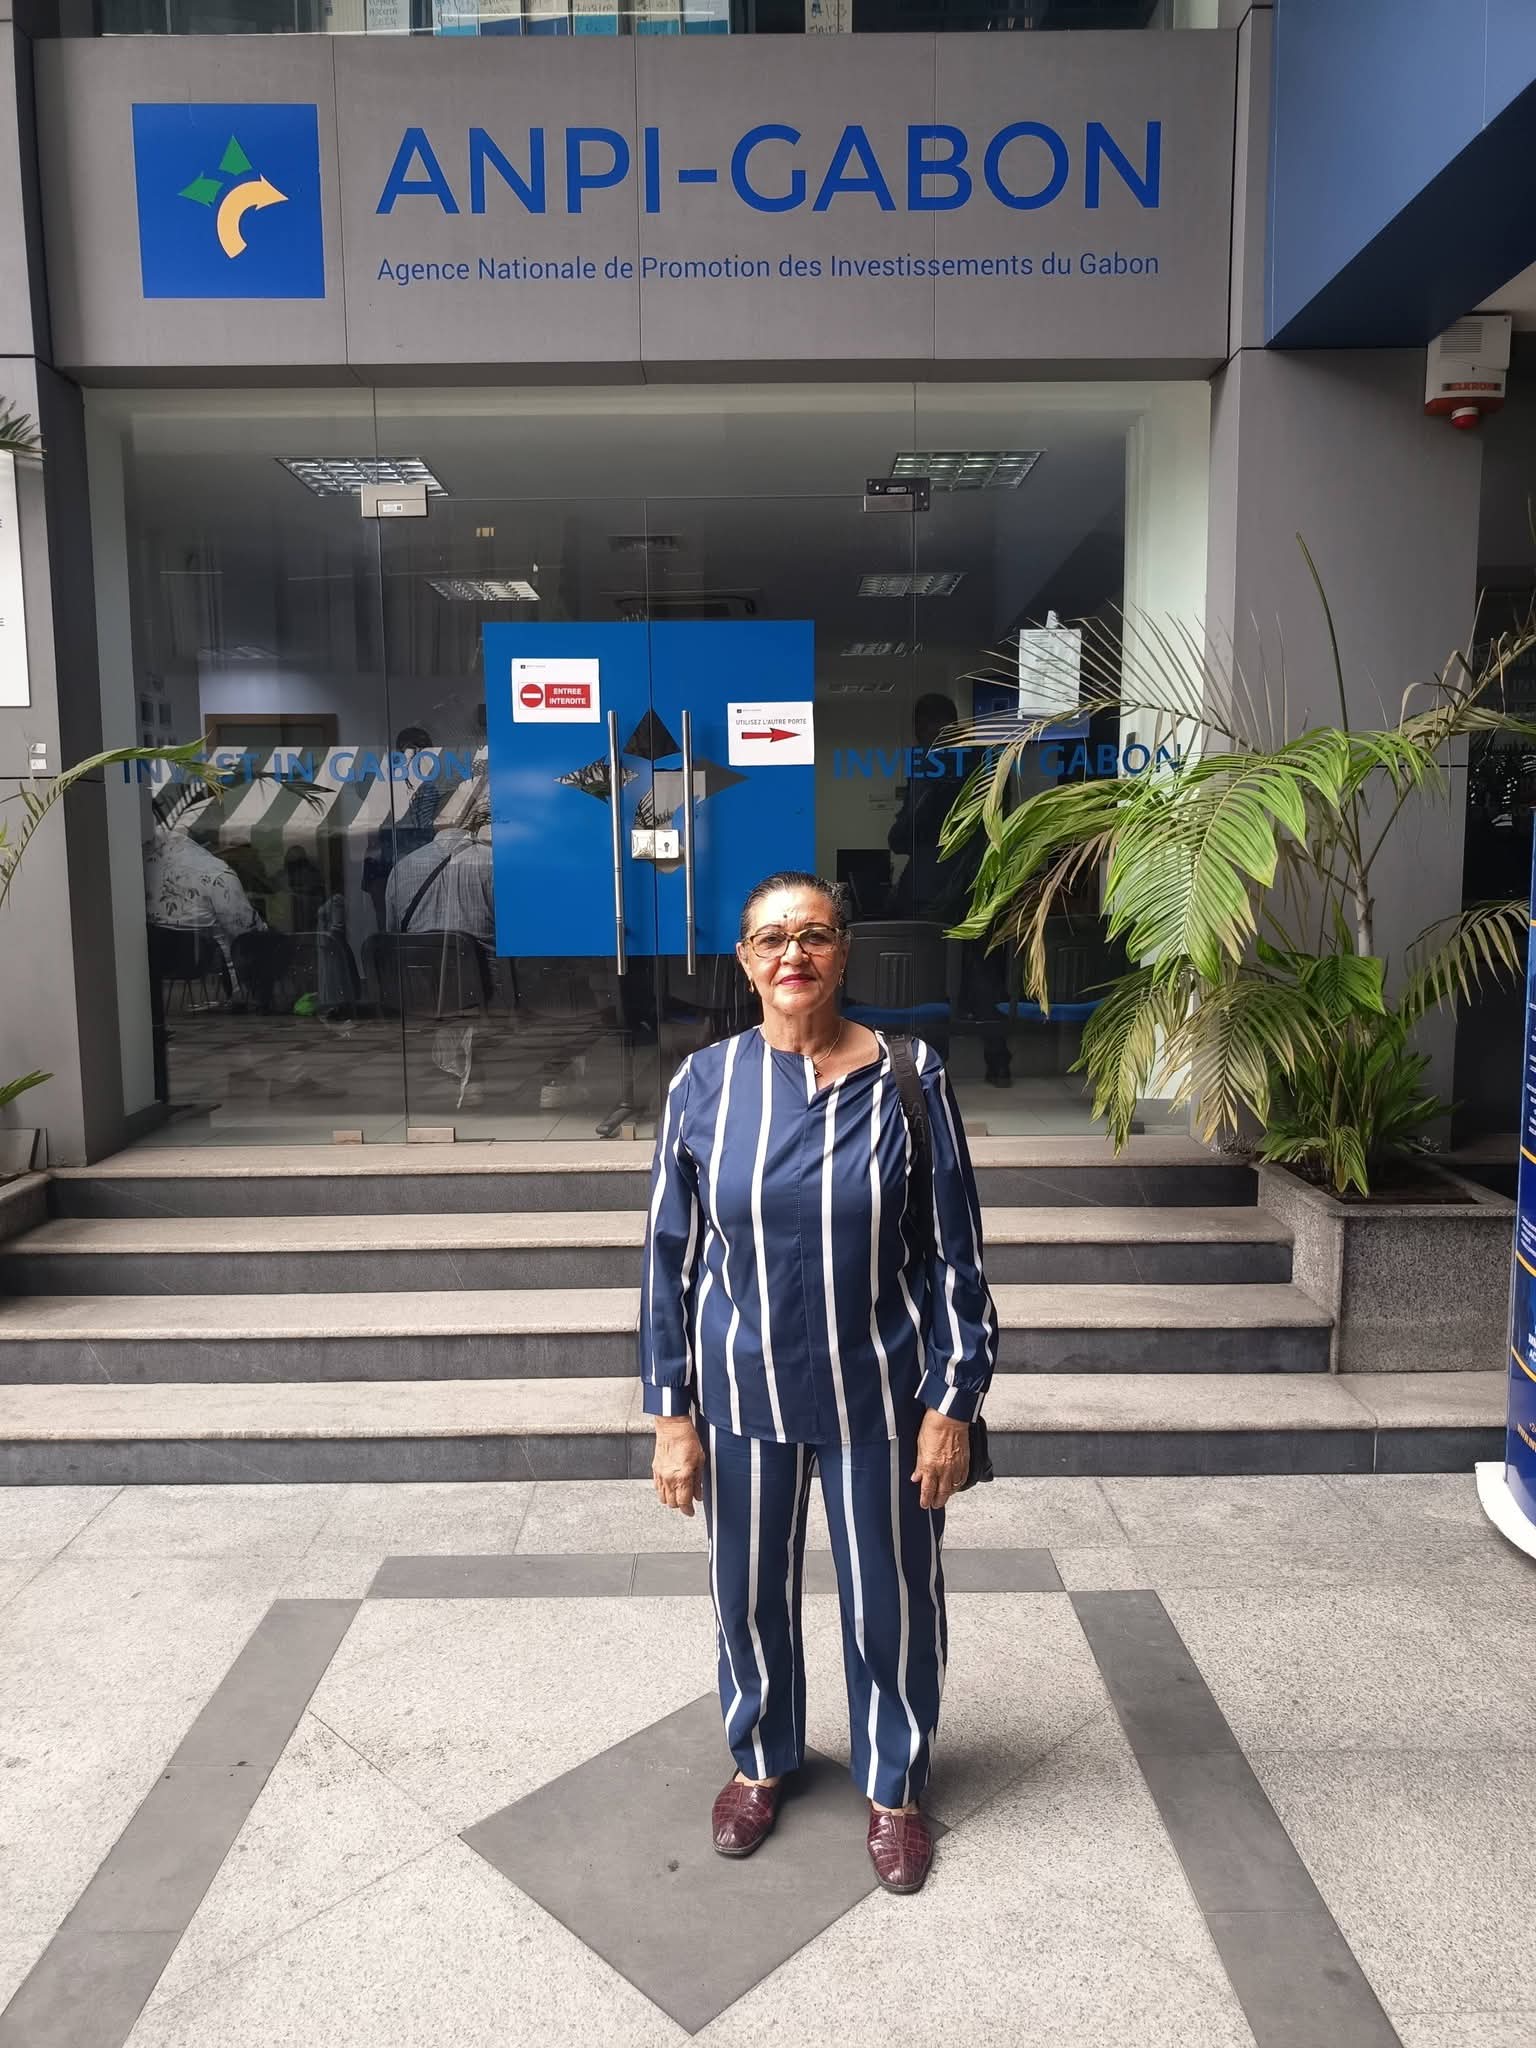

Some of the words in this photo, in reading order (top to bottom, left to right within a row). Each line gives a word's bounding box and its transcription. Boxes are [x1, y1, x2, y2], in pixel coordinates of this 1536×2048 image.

[377, 122, 1160, 214] ANPI-GABON
[378, 259, 469, 285] Agence
[477, 256, 596, 279] Nationale
[603, 256, 633, 279] de
[641, 255, 770, 278] Promotion
[779, 254, 821, 277] des
[831, 253, 1032, 277] Investissements
[1041, 253, 1073, 276] du
[1081, 252, 1159, 275] Gabon
[549, 697, 587, 705] INTERDITE
[762, 718, 786, 726] L'AUTRE
[275, 752, 314, 783] IN
[329, 751, 472, 783] GABON
[833, 746, 973, 780] INVEST
[984, 745, 1025, 778] I
[1039, 743, 1182, 776] GABON
